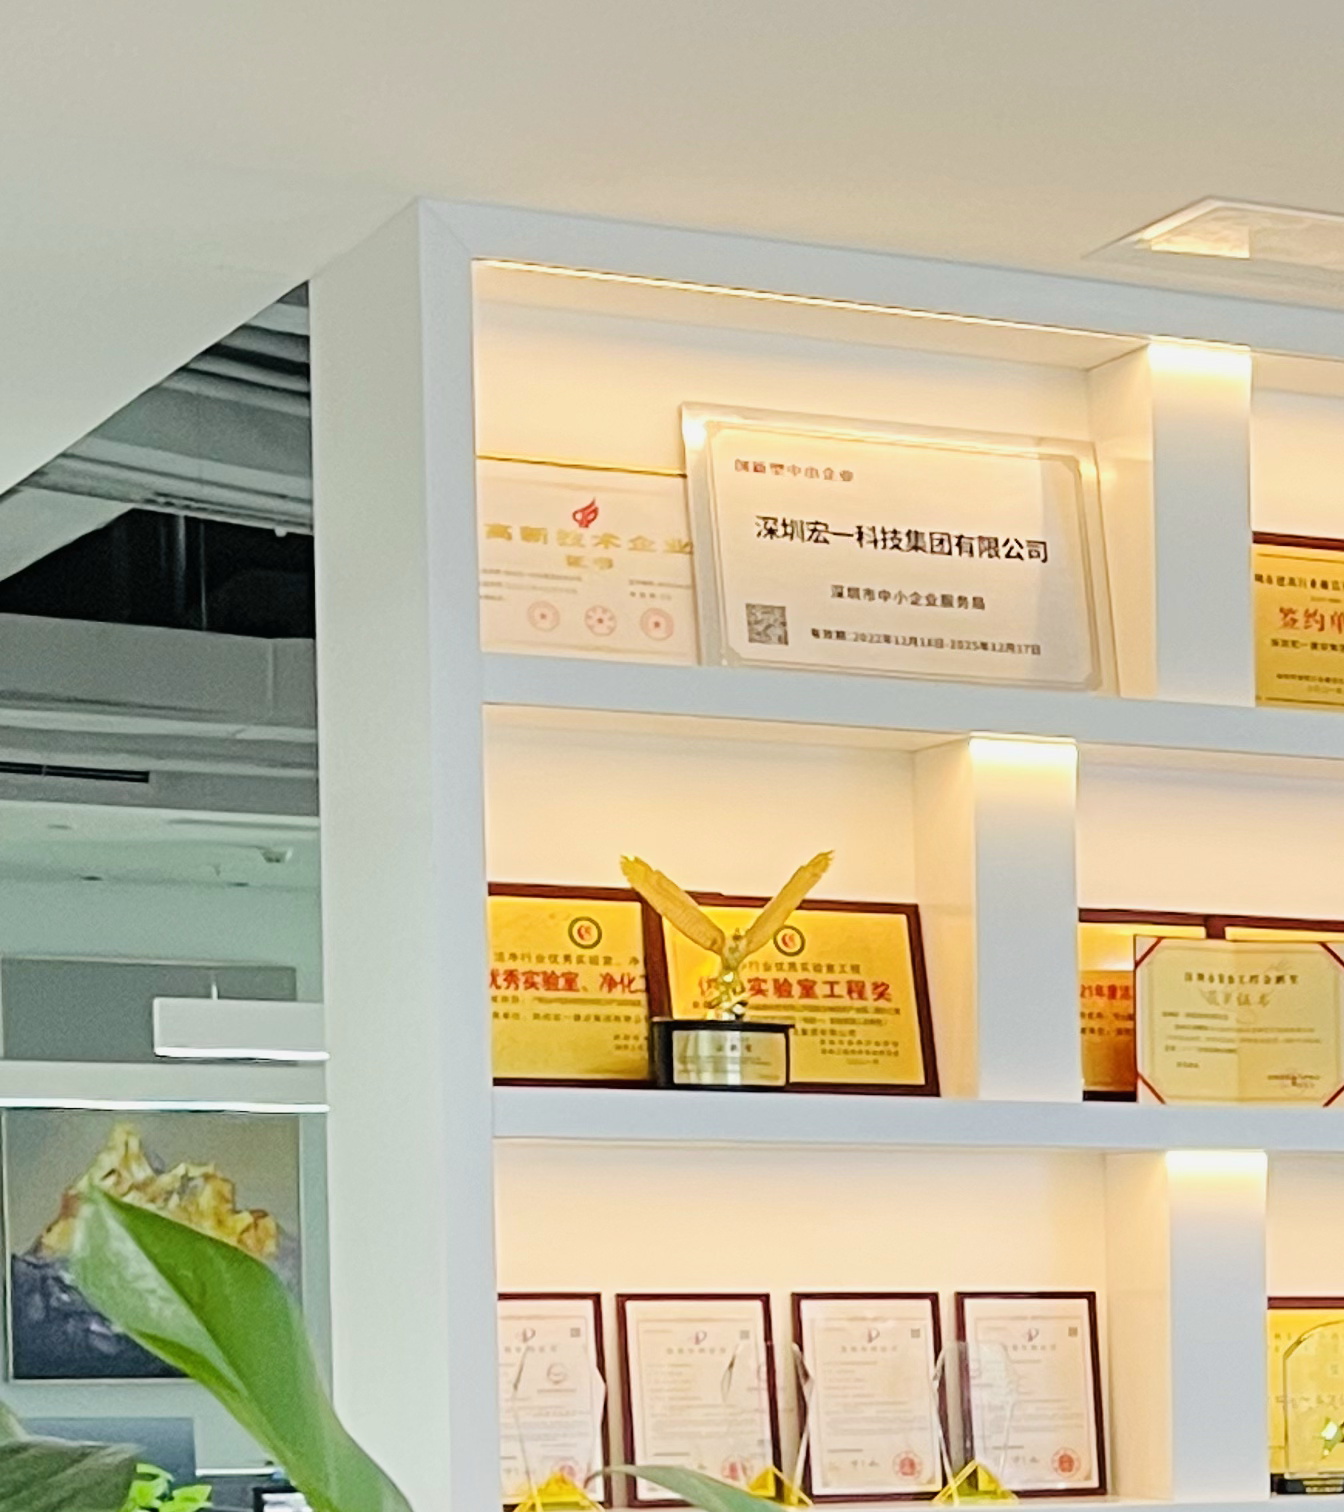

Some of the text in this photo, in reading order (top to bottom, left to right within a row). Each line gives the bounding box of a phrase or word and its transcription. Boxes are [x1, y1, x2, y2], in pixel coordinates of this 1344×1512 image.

[755, 514, 1049, 564] 深圳宏一科技集团有限公司
